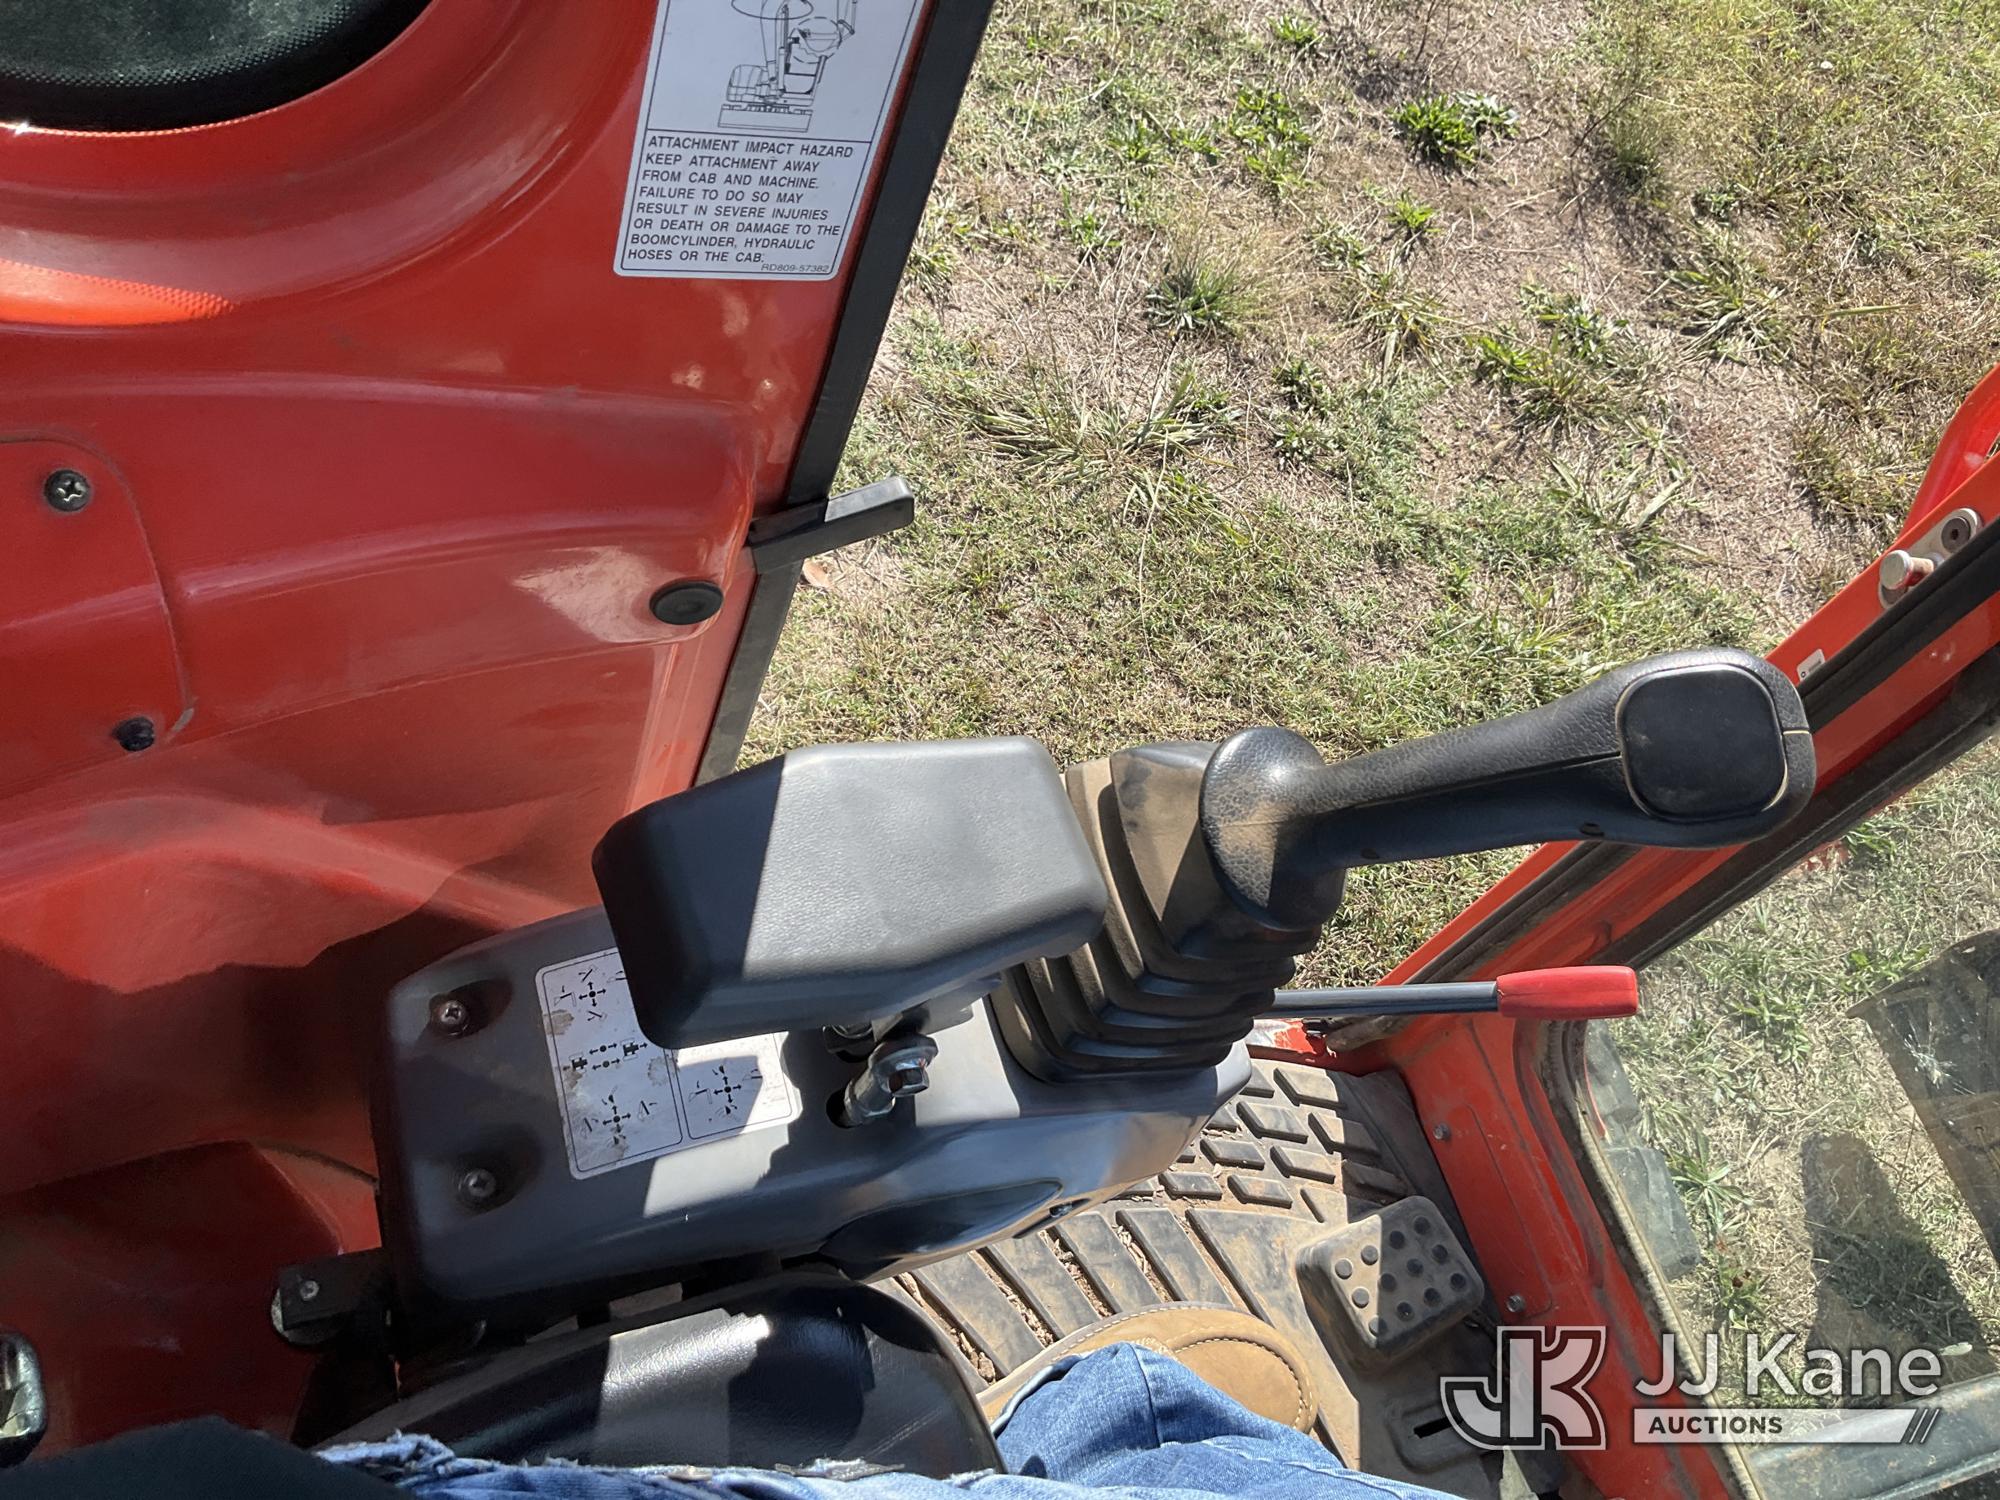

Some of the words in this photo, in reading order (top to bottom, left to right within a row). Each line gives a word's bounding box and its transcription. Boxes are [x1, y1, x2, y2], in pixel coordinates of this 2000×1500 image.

[648, 136, 739, 152] ATTACHMENT
[745, 141, 794, 154] IMPACT
[800, 144, 853, 158] HAZARD
[645, 153, 682, 165] KEEP
[689, 156, 777, 170] ATTACHMENT
[783, 160, 820, 172] AWAY
[642, 170, 681, 182] FROM
[688, 172, 716, 184] CAB
[724, 174, 752, 186] AND
[758, 176, 819, 189] MACHINE.
[639, 186, 696, 199] FAILURE
[702, 189, 718, 200] TO
[726, 190, 744, 201] DO
[752, 192, 770, 202] SO
[776, 192, 804, 204] MAY
[636, 202, 688, 215] RESULT
[694, 205, 708, 215] IN
[714, 206, 765, 218] SEVERE
[772, 208, 828, 220] INJURIES
[634, 218, 652, 228] OR
[660, 219, 703, 231] DEATH
[710, 221, 728, 232] OR
[736, 222, 789, 234] DAMAGE
[796, 224, 812, 234] TO
[818, 225, 841, 236] THE
[631, 234, 738, 248] BOOMCYLINDER,
[744, 238, 815, 250] HYDRAULIC
[628, 249, 672, 260] HOSES
[680, 250, 698, 260] OR
[705, 252, 728, 262] THE
[760, 264, 829, 272] RD809-57382
